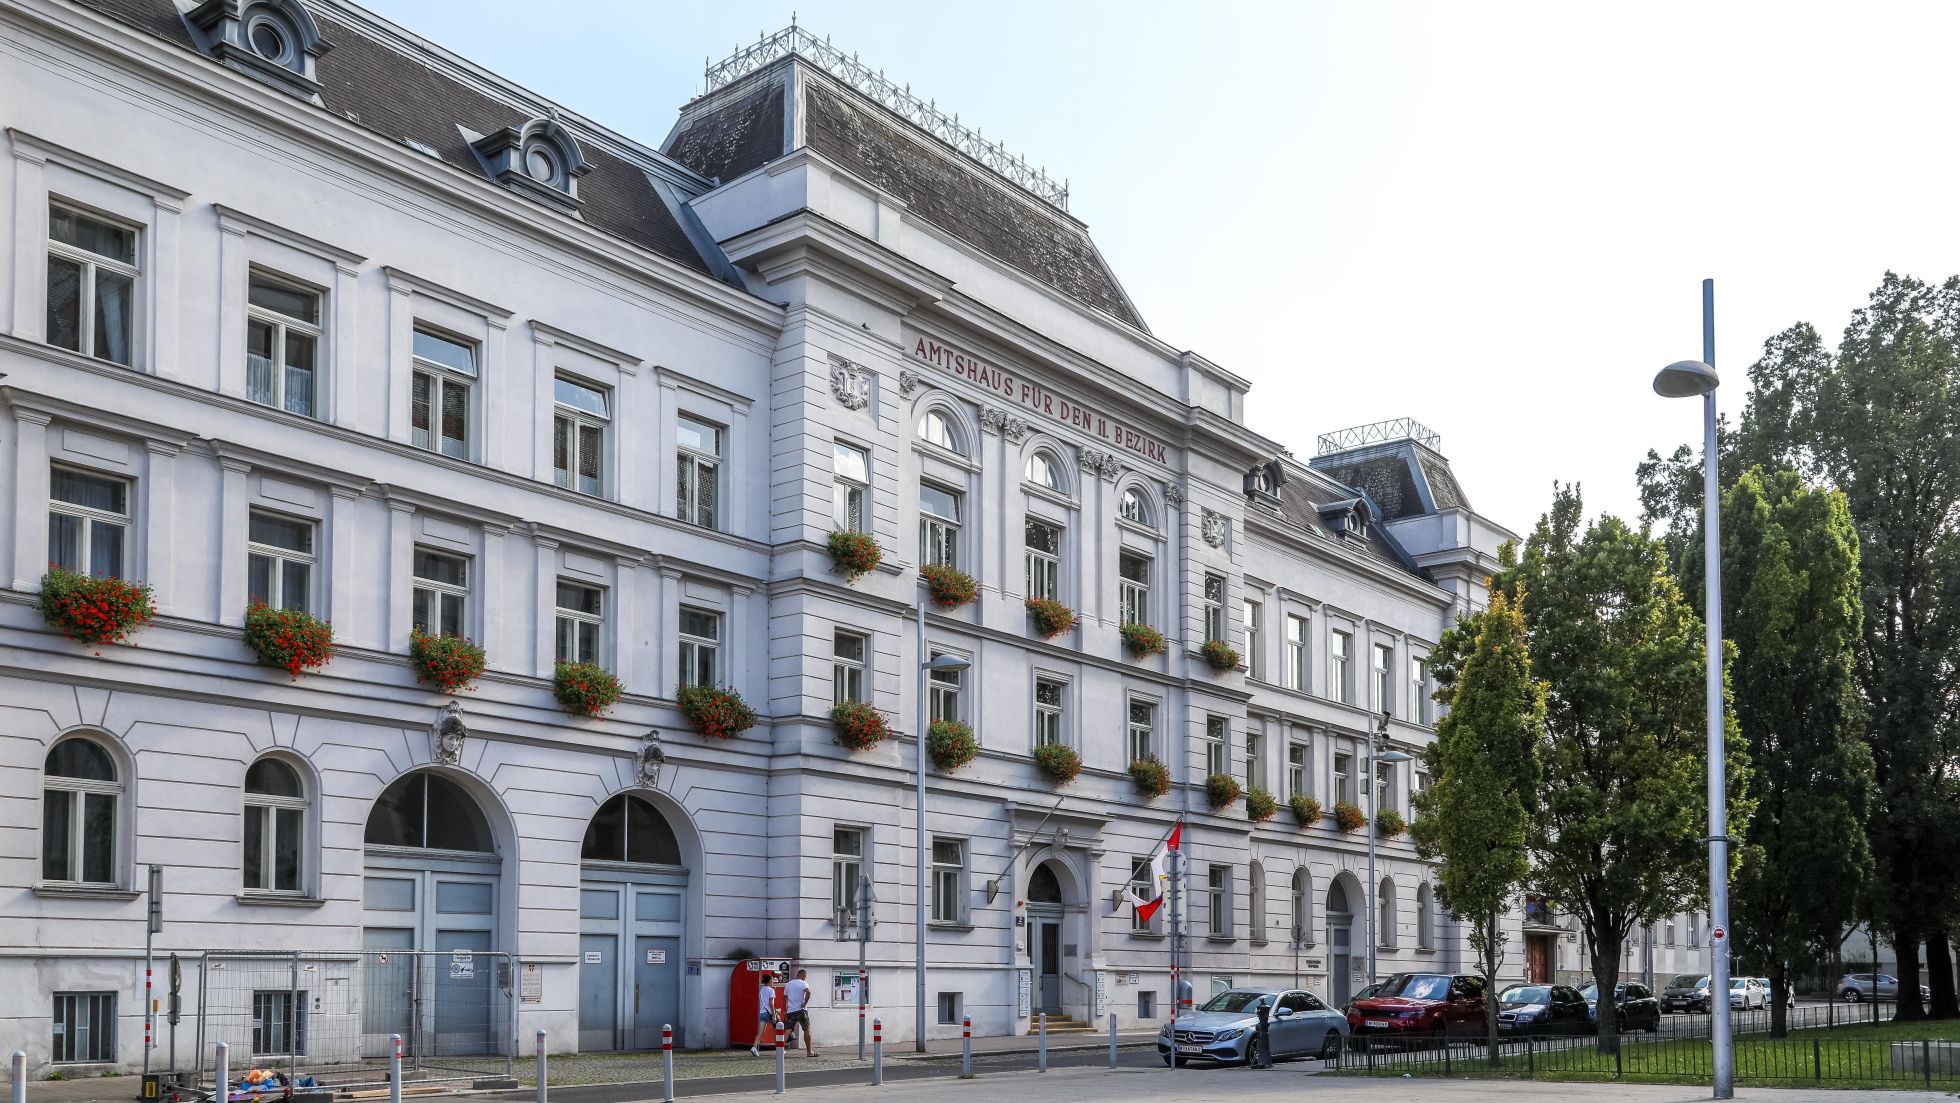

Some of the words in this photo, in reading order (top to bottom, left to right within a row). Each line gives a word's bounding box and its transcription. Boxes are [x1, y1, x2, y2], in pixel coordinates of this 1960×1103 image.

[915, 337, 1014, 396] AMTSHAUS
[1021, 383, 1053, 415] FÜR
[1060, 400, 1091, 431] DEN
[1115, 425, 1167, 464] BEZIRK
